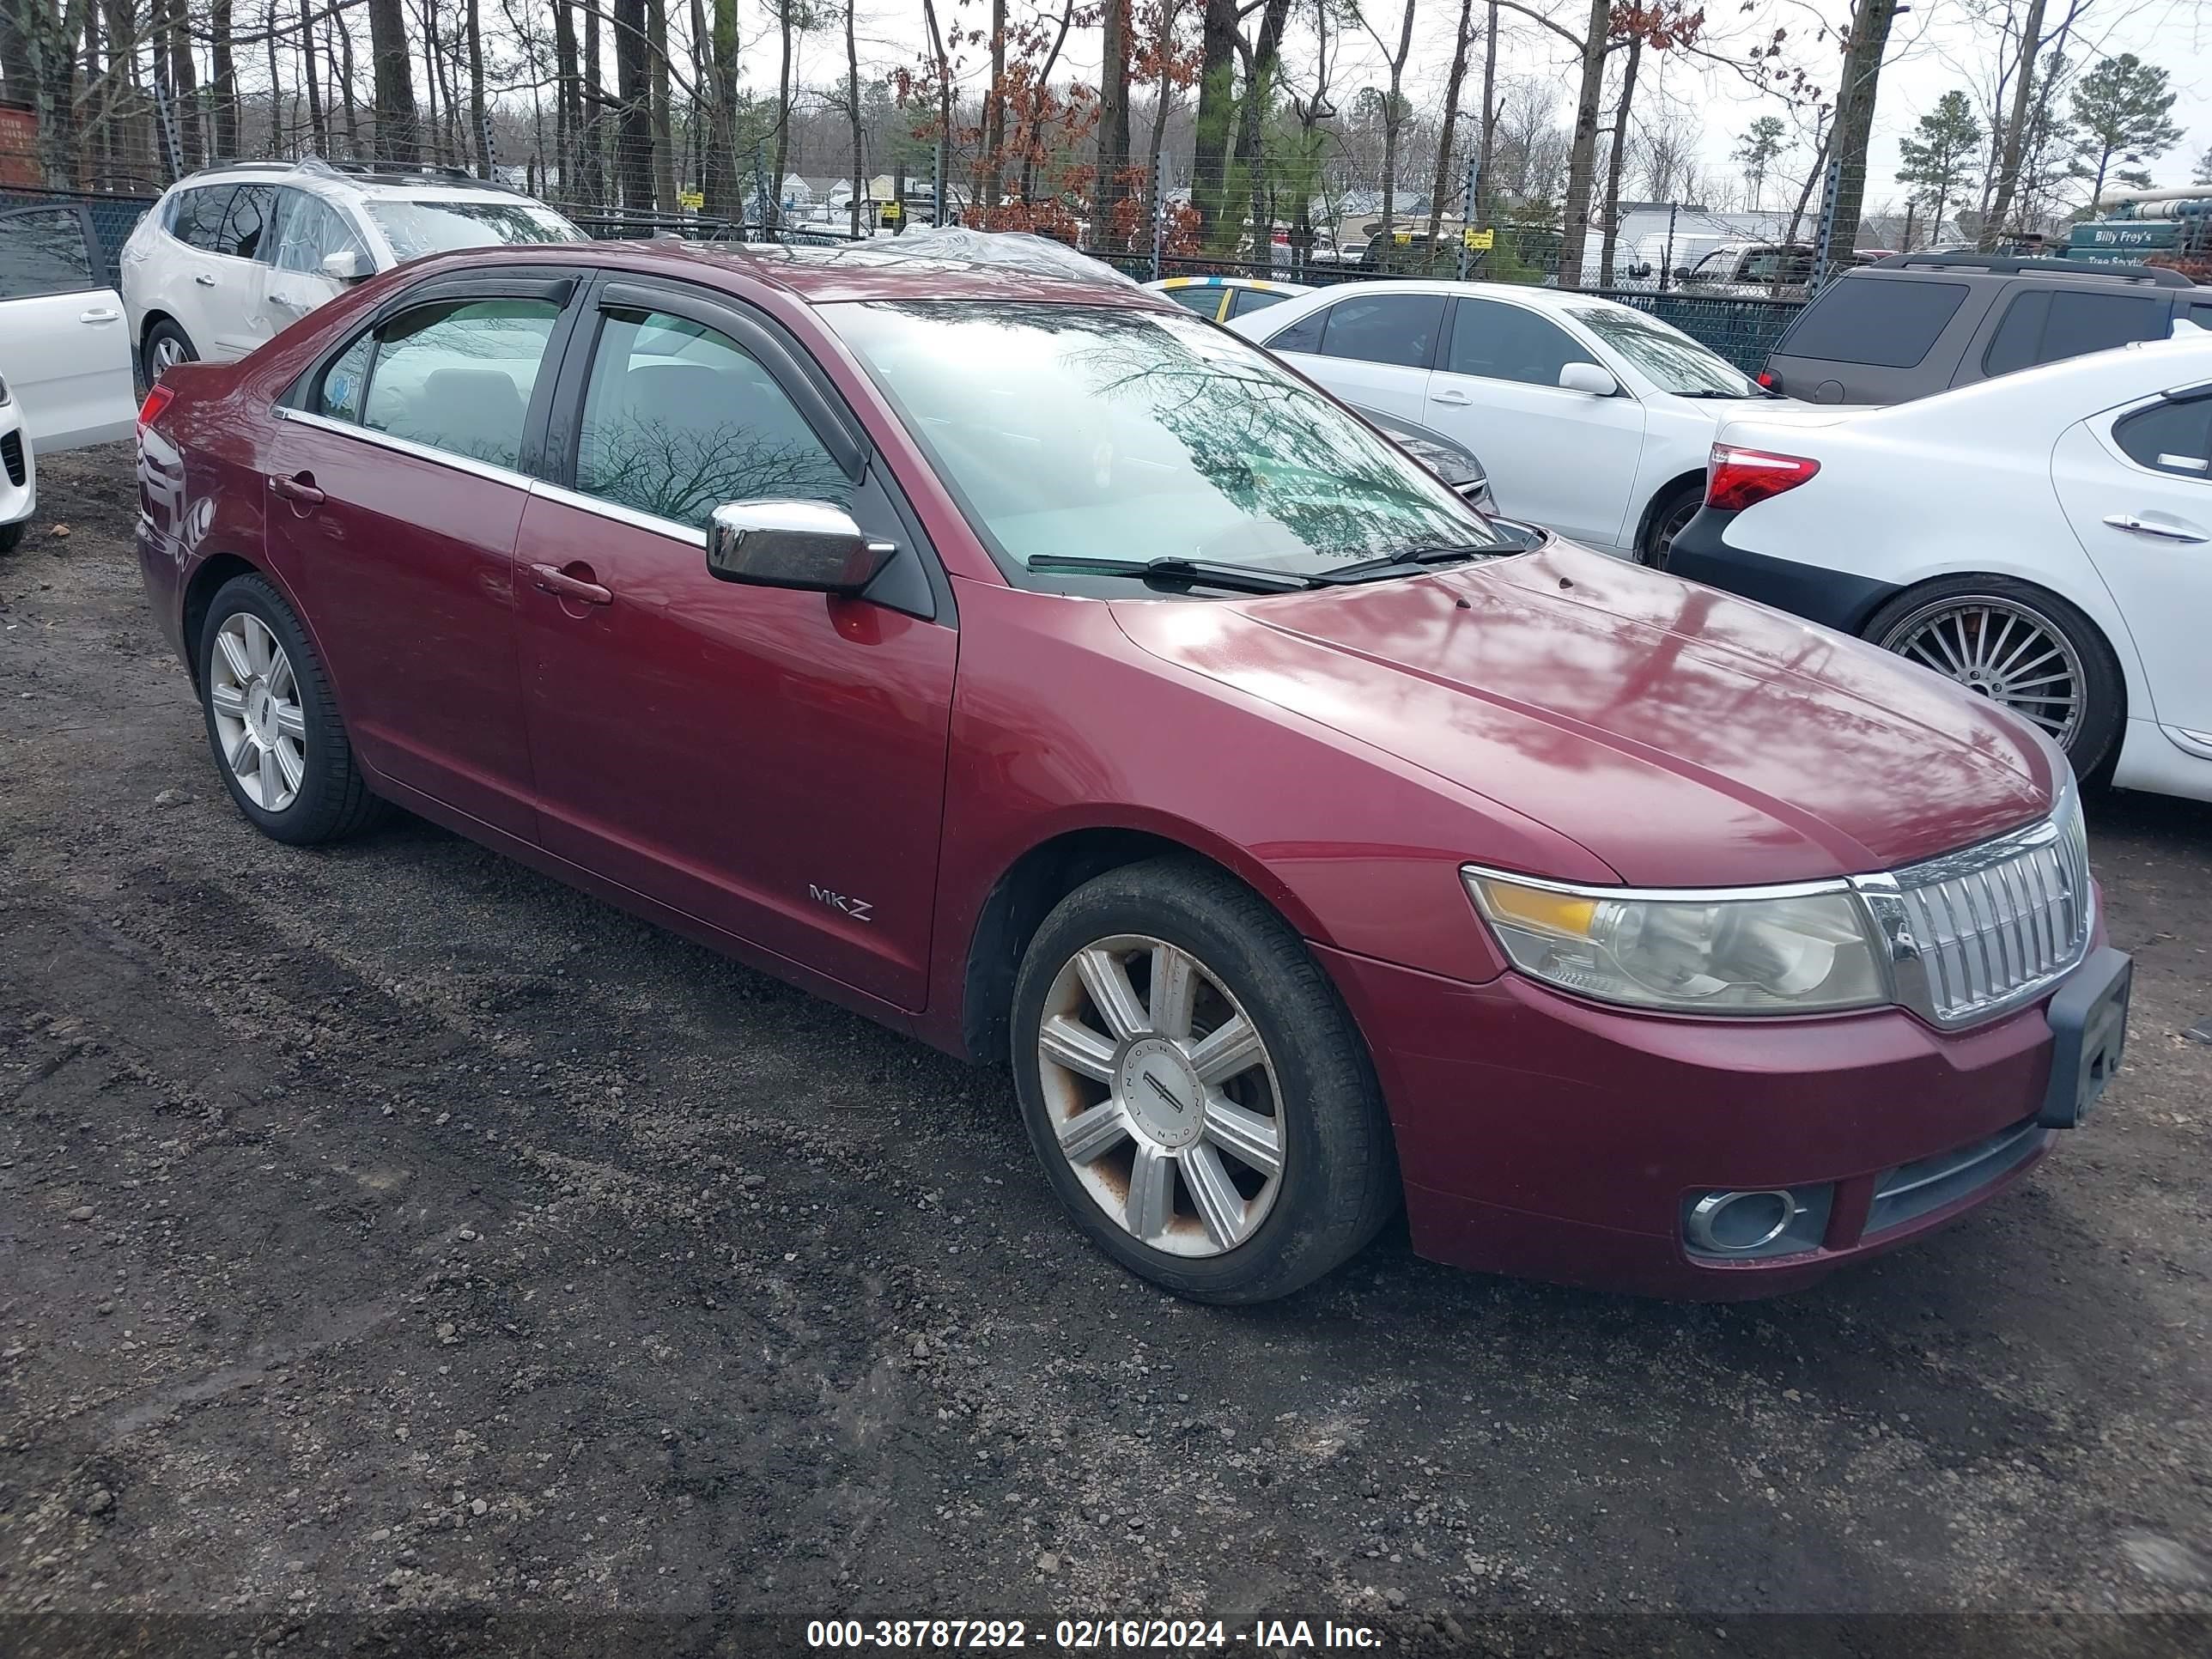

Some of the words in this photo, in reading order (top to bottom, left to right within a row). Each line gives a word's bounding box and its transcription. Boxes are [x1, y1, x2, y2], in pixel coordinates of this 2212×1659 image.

[2095, 230, 2118, 244] Billy
[2120, 230, 2152, 244] Frey's
[809, 884, 873, 921] MKZ
[1125, 1044, 1169, 1116] LINCOLN
